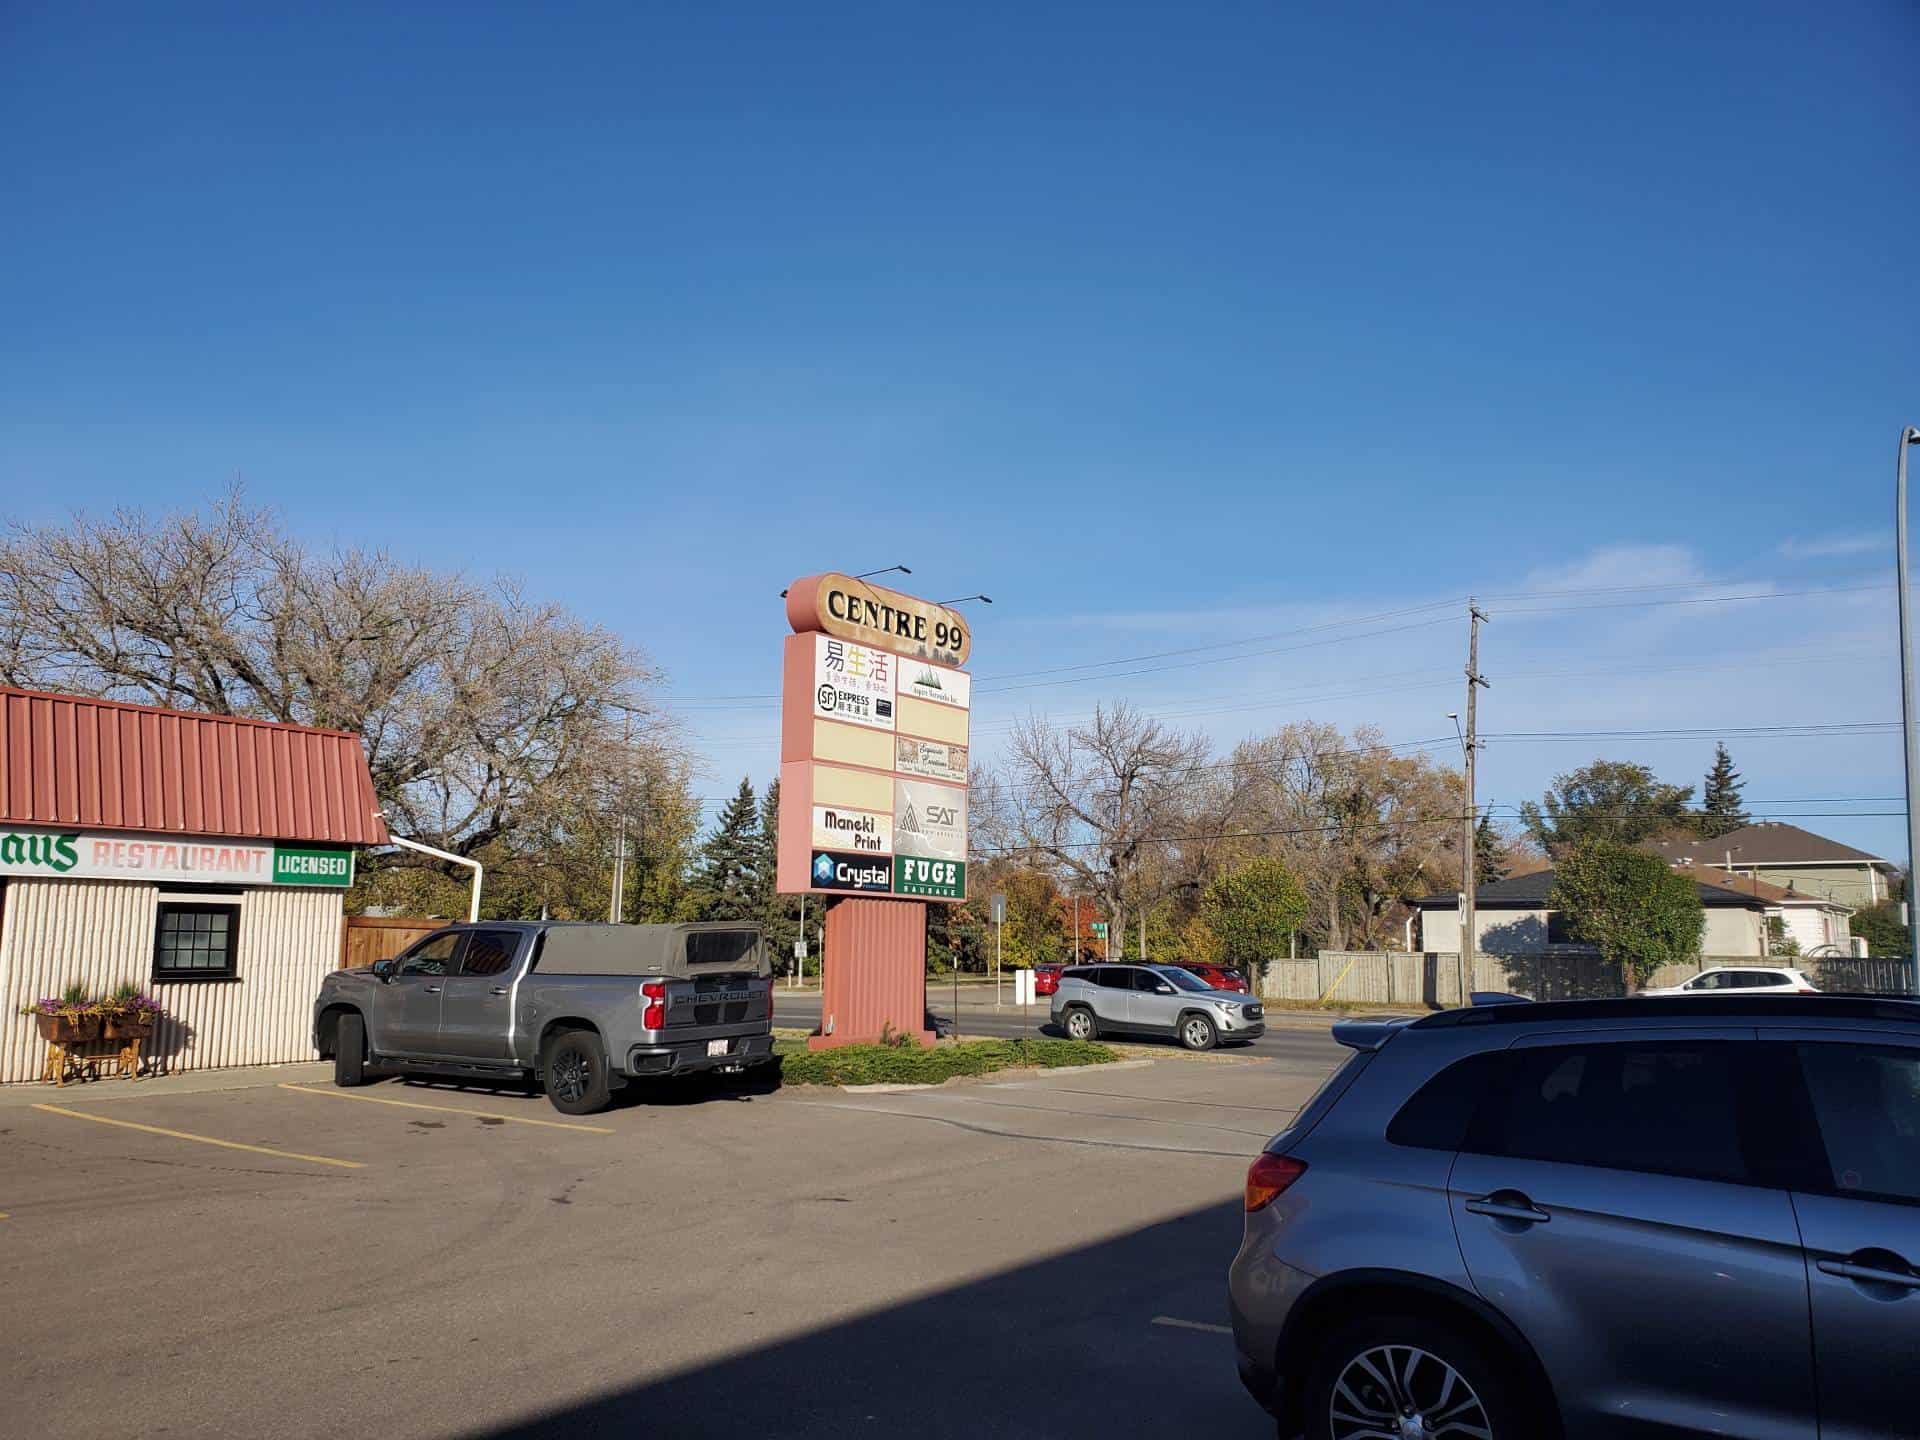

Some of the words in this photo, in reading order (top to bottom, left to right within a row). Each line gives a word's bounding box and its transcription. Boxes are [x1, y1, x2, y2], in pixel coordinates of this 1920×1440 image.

[828, 590, 927, 642] CENTRE
[935, 622, 963, 650] 99
[825, 640, 888, 682] 易生活
[838, 690, 870, 705] EXPRESS
[825, 811, 875, 833] Maneki
[926, 806, 959, 826] SAT
[854, 834, 882, 851] Print
[93, 841, 266, 874] RESTAURANT
[278, 855, 347, 876] LICENSED
[836, 863, 889, 888] Crystal
[904, 859, 957, 884] FUGE
